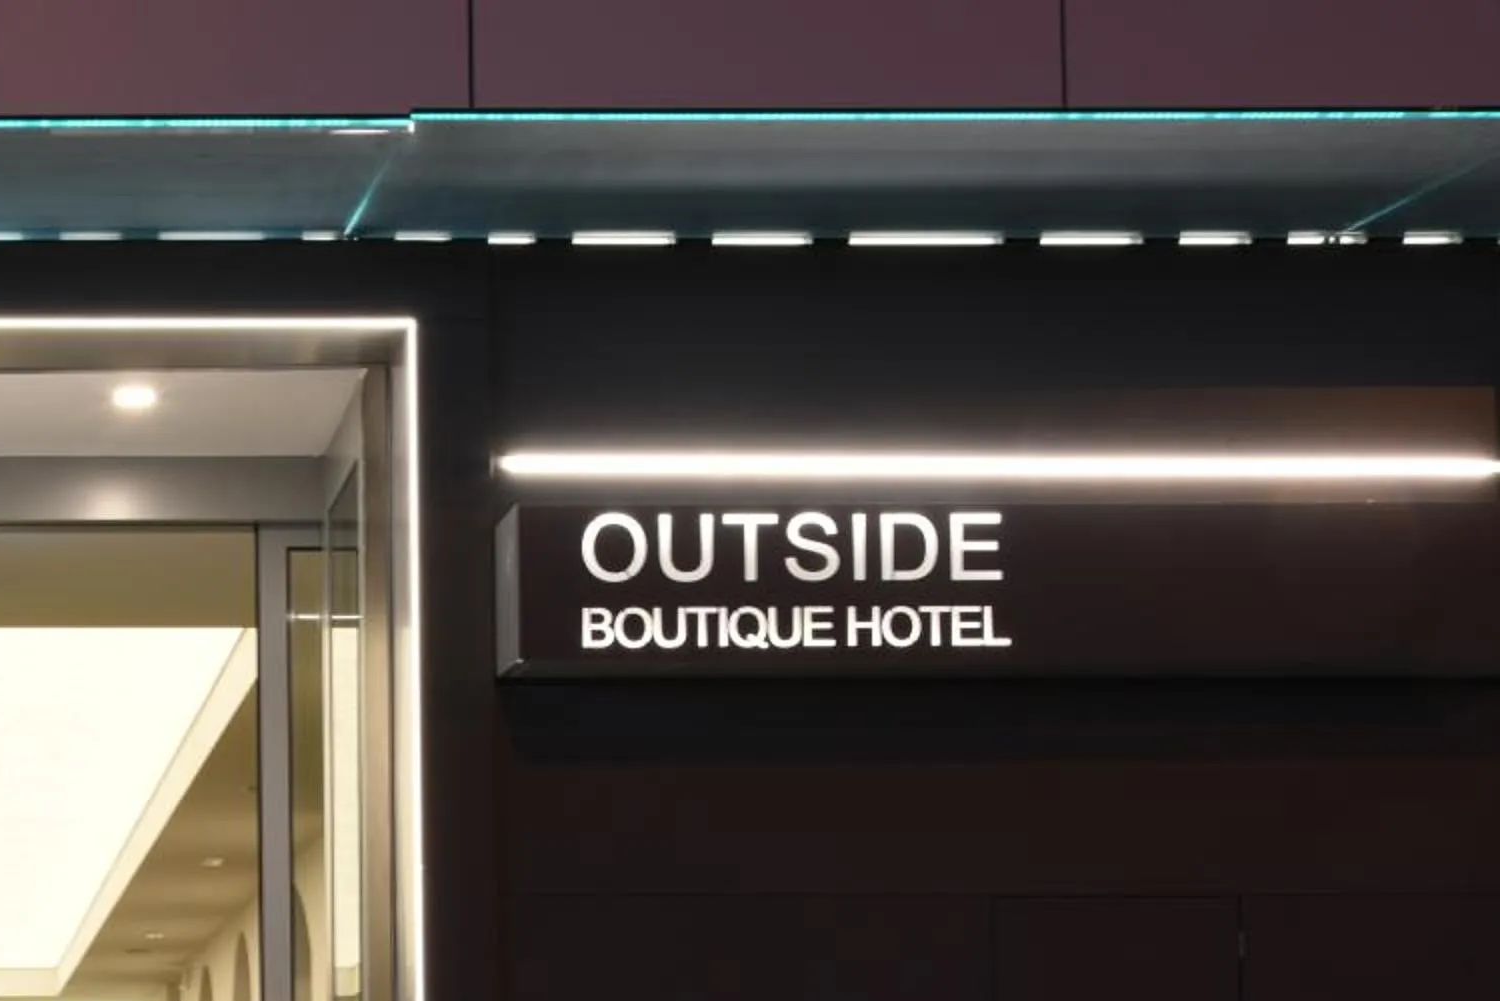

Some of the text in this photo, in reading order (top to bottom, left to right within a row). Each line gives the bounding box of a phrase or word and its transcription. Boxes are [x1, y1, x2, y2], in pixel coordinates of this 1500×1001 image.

[581, 511, 1004, 583] OUTSIDE
[581, 605, 1012, 649] BOUTIQUE HOTEL
